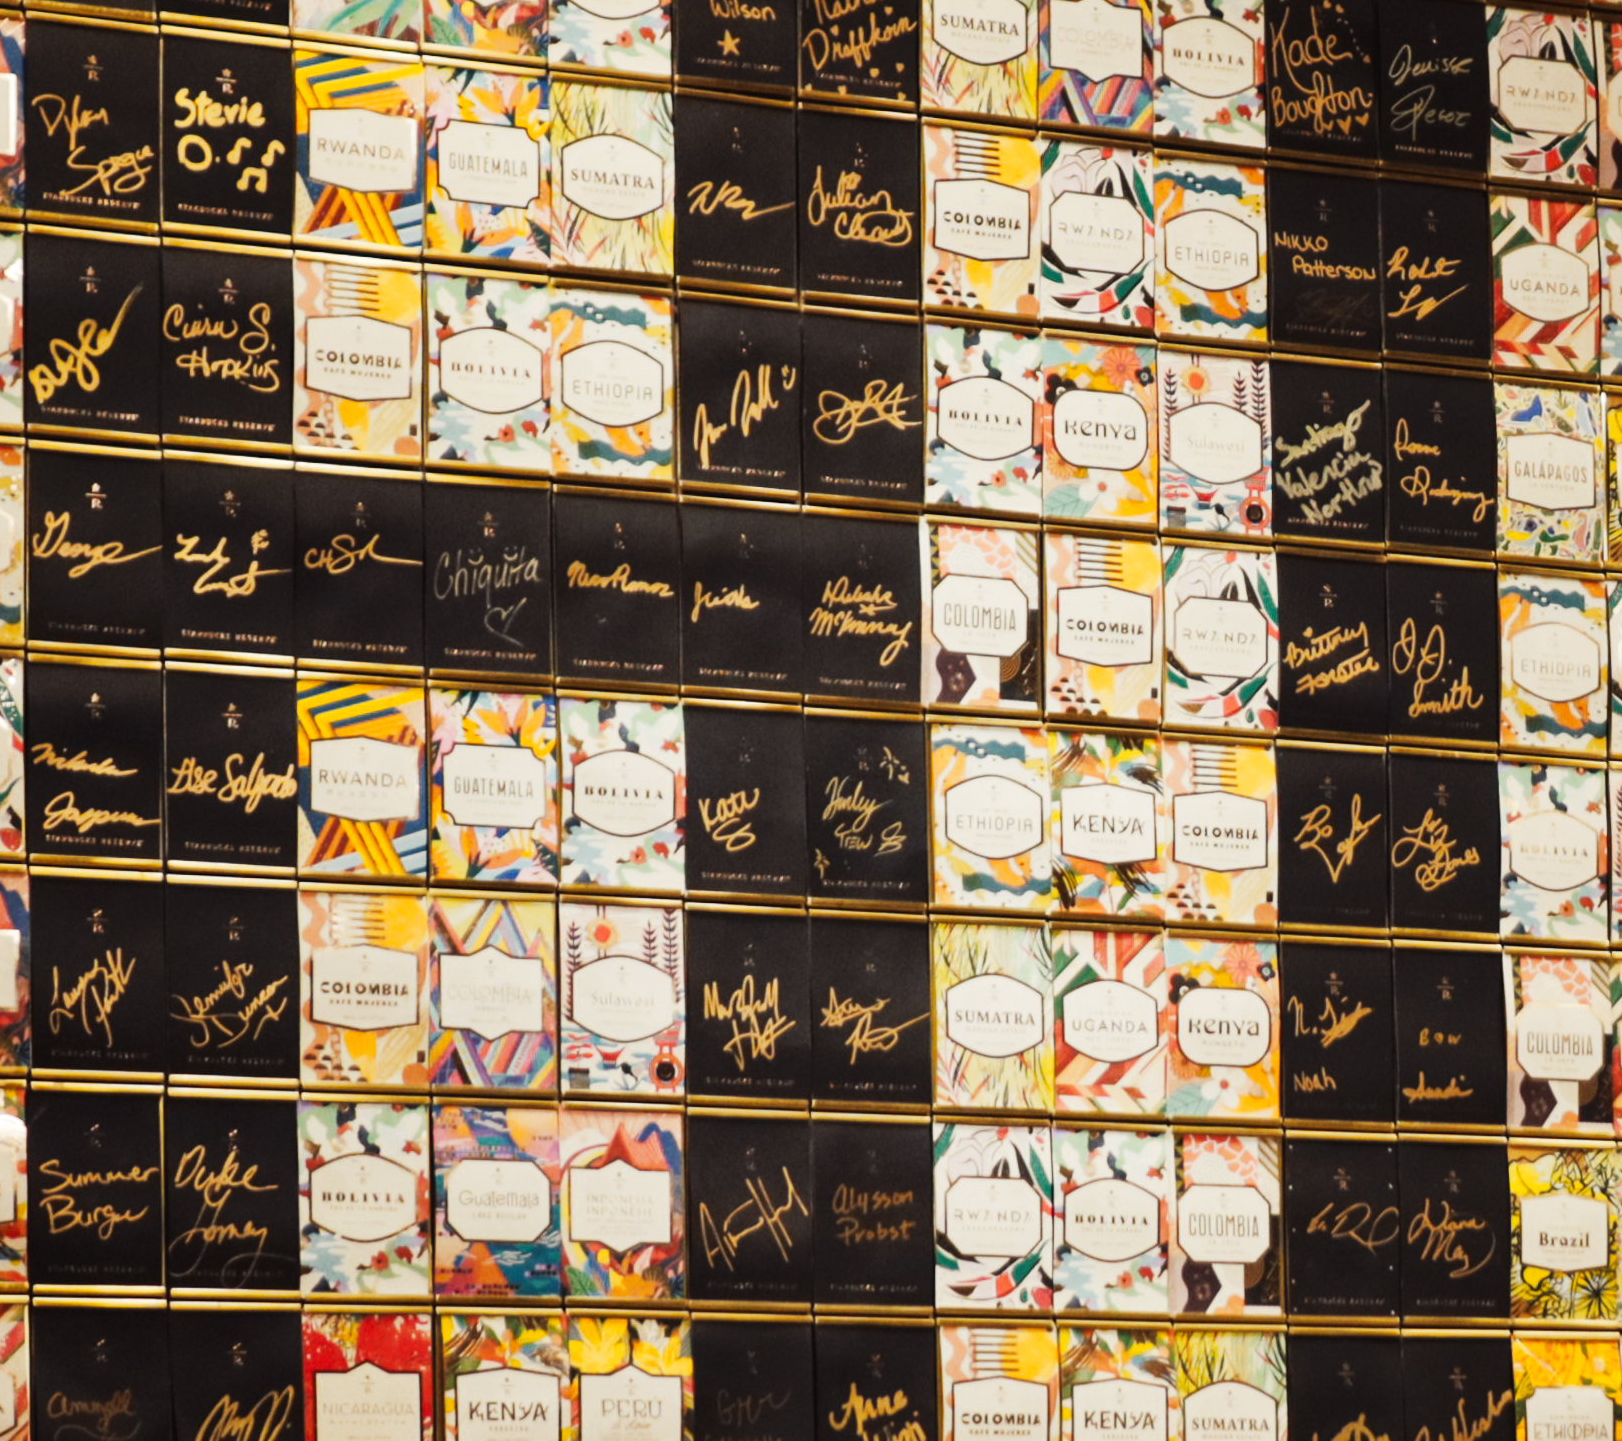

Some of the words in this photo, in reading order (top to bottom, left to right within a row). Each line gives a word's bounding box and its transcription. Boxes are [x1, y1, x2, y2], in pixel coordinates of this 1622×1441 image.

[941, 15, 1019, 36] SUMATRA
[174, 84, 265, 128] Stevie
[571, 169, 655, 190] SUMATRA
[944, 211, 1021, 230] COLOMBIA
[318, 769, 404, 788] RWANDA
[584, 786, 663, 799] BOLIVIA
[1188, 1019, 1259, 1036] Kenya
[469, 1402, 546, 1421] KENYA
[601, 1399, 662, 1419] PERÚ
[1192, 1418, 1269, 1431] SUMATRA
